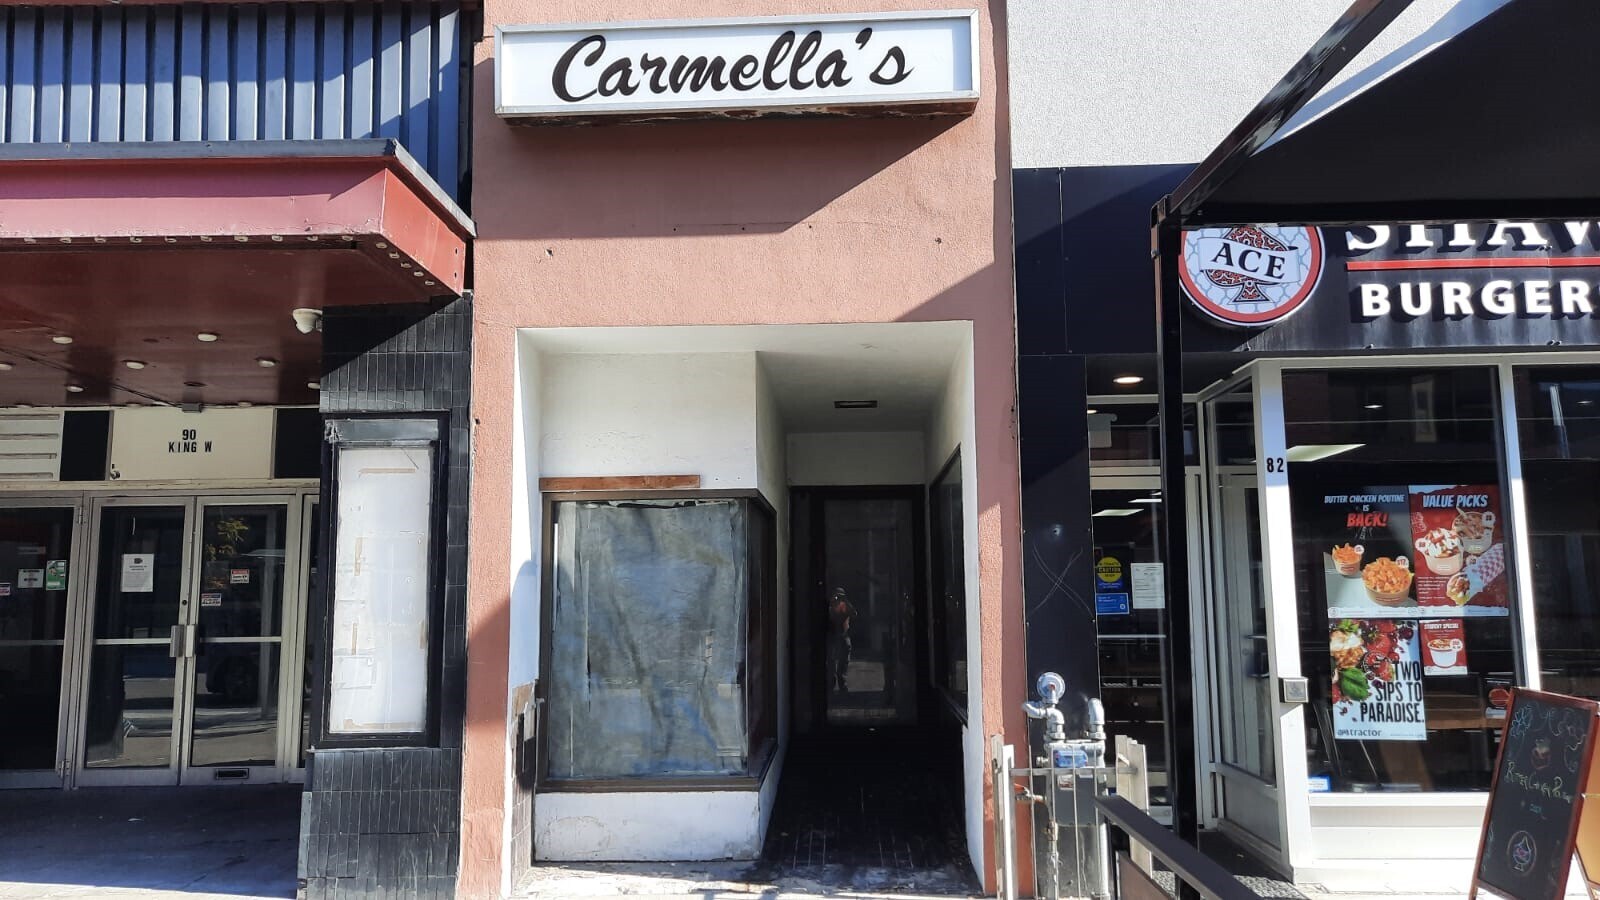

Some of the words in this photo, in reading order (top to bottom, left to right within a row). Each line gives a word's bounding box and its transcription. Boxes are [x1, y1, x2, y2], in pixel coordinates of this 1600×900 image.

[552, 27, 915, 103] Carmella's
[1210, 242, 1286, 280] ACE
[1360, 280, 1593, 317] BURGER
[182, 428, 197, 441] 90
[168, 440, 197, 453] KING
[204, 440, 213, 453] W
[1266, 457, 1284, 473] 82
[1324, 495, 1348, 504] BUTTER
[1349, 495, 1377, 503] CHICKEN
[1377, 494, 1406, 503] POUTINE
[1423, 495, 1454, 508] VALUE
[1456, 494, 1488, 508] PICKS
[1362, 504, 1370, 512] IS
[1347, 512, 1389, 527] BACK!
[1393, 660, 1421, 681] TWO
[1375, 681, 1403, 702] SIPS
[1406, 681, 1422, 702] TO
[1360, 702, 1425, 723] PARADISE.
